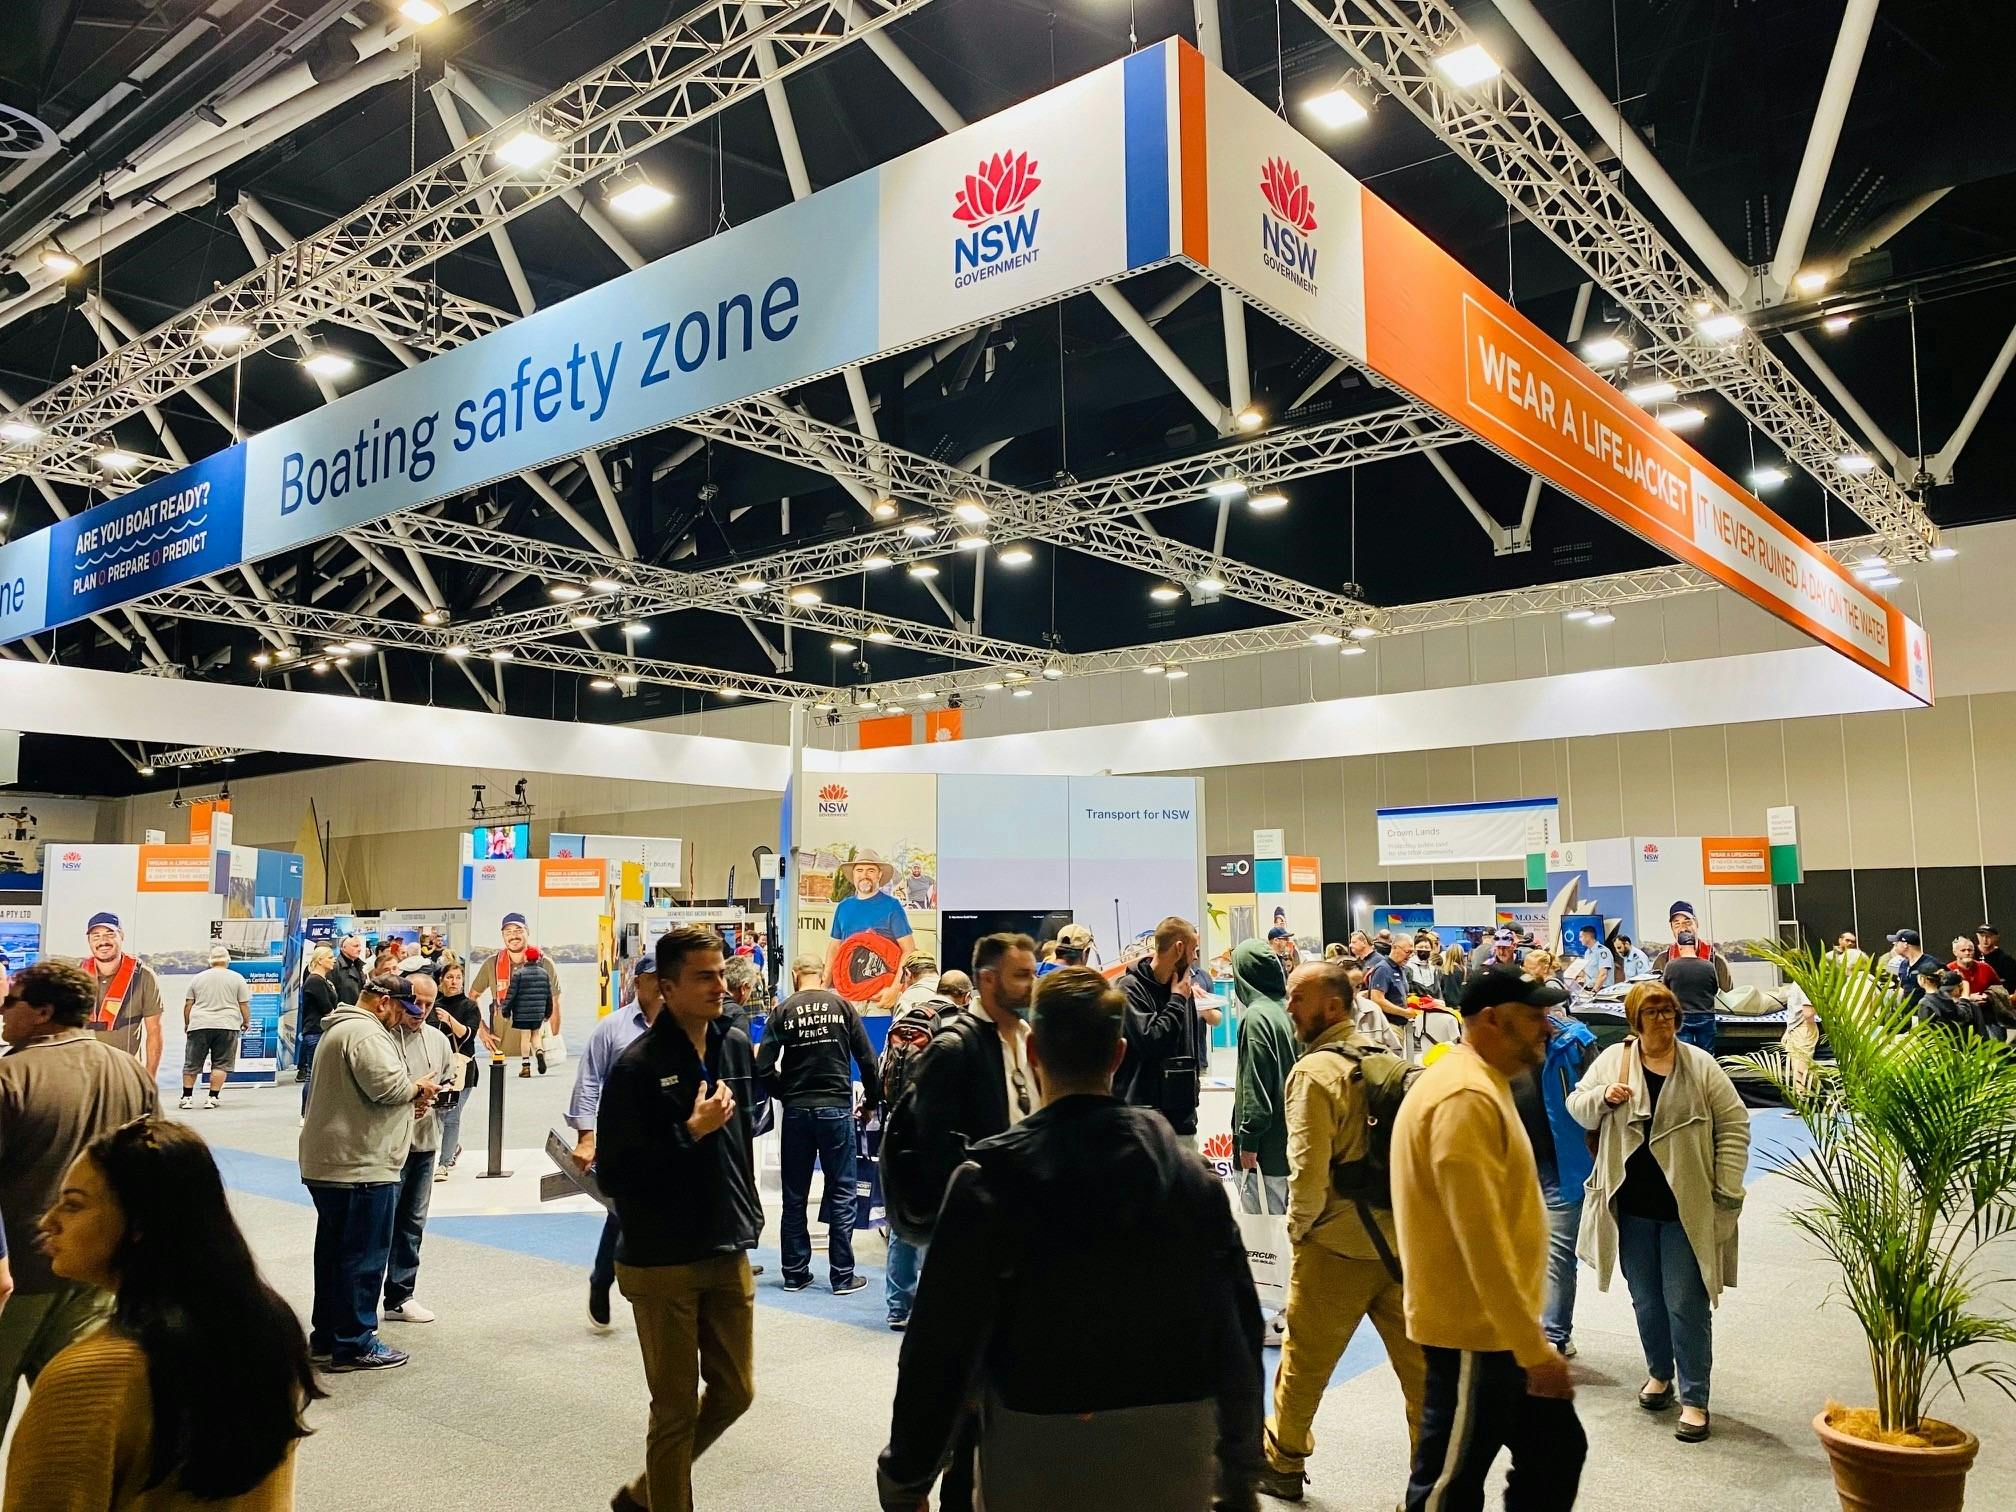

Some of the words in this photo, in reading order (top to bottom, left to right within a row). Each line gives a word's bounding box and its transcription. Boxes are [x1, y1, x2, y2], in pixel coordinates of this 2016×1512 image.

[954, 208, 1040, 273] NSW
[1262, 212, 1318, 281] NSW
[954, 248, 1040, 289] GOVERNMENT
[1263, 253, 1319, 297] GOVERNMENT
[280, 409, 440, 516] Boating
[453, 340, 623, 452] safety
[640, 276, 800, 388] zone
[1478, 335, 1556, 430] WEAR
[1562, 398, 1578, 444] A
[1582, 410, 1688, 516] LIFEJACKET
[75, 530, 98, 556] ARE
[100, 516, 124, 547] YOU
[126, 506, 158, 536] BOAT
[159, 481, 211, 523] READY?
[73, 572, 97, 595] PLAN
[107, 553, 150, 584] PREPARE
[162, 531, 208, 563] PREDICT
[1696, 492, 1709, 529] IT
[1712, 503, 1756, 562] NEVER
[1759, 536, 1799, 589] RUINED
[1801, 569, 1807, 593] A
[1808, 573, 1828, 606] DAY
[1829, 586, 1842, 617] ON
[1842, 597, 1860, 631] THE
[1860, 608, 1886, 648] WATER
[819, 803, 848, 813] NSW
[1086, 809, 1140, 820] Transport
[1144, 809, 1159, 819] for
[1162, 809, 1189, 819] NSW
[1387, 829, 1413, 838] Crown
[1415, 828, 1440, 837] Lands
[6, 910, 18, 919] PTY
[20, 910, 31, 919] LTD
[1515, 914, 1548, 922] M.O.S.S.
[784, 1019, 794, 1030] EX
[798, 1014, 845, 1028] MACHINA
[796, 1002, 829, 1015] DEUS
[798, 1026, 829, 1038] VENICE
[1247, 1251, 1278, 1261] ERCURY
